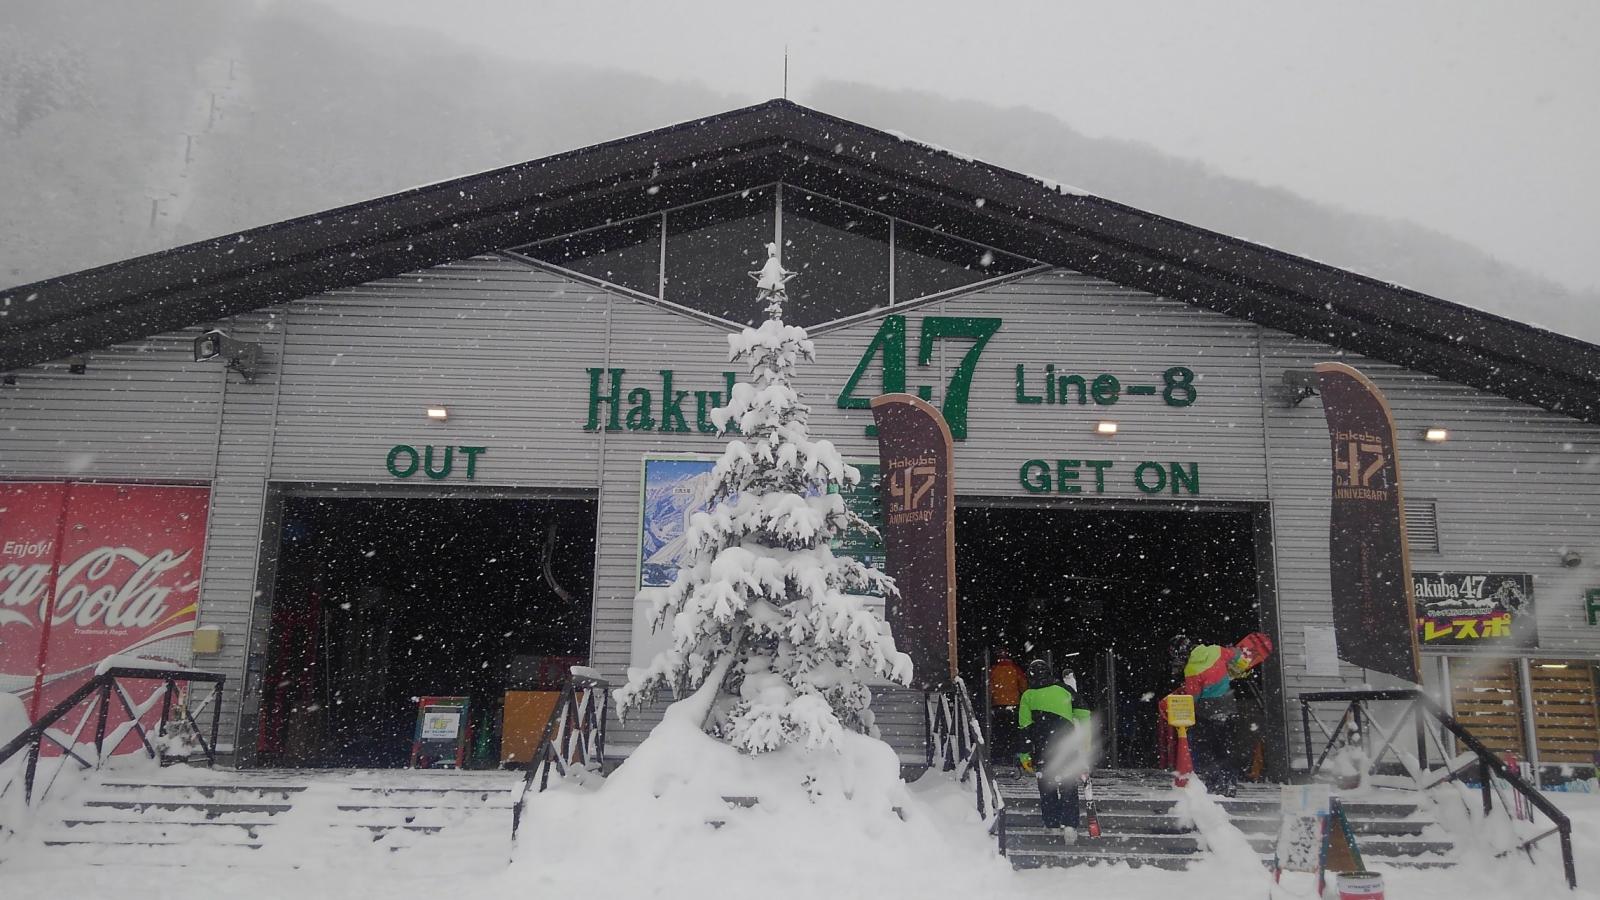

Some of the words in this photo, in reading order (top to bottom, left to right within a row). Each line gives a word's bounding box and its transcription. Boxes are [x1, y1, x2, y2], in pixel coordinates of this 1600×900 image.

[837, 314, 1003, 441] 47
[386, 443, 488, 480] OUT
[888, 455, 937, 470] Hakuba
[1019, 458, 1113, 494] GET
[1133, 460, 1201, 495] ON
[1335, 441, 1385, 487] 47
[889, 466, 937, 511] 47
[4, 541, 53, 559] Enjoy!
[1460, 575, 1487, 599] 47
[1416, 612, 1512, 641] レスポ
